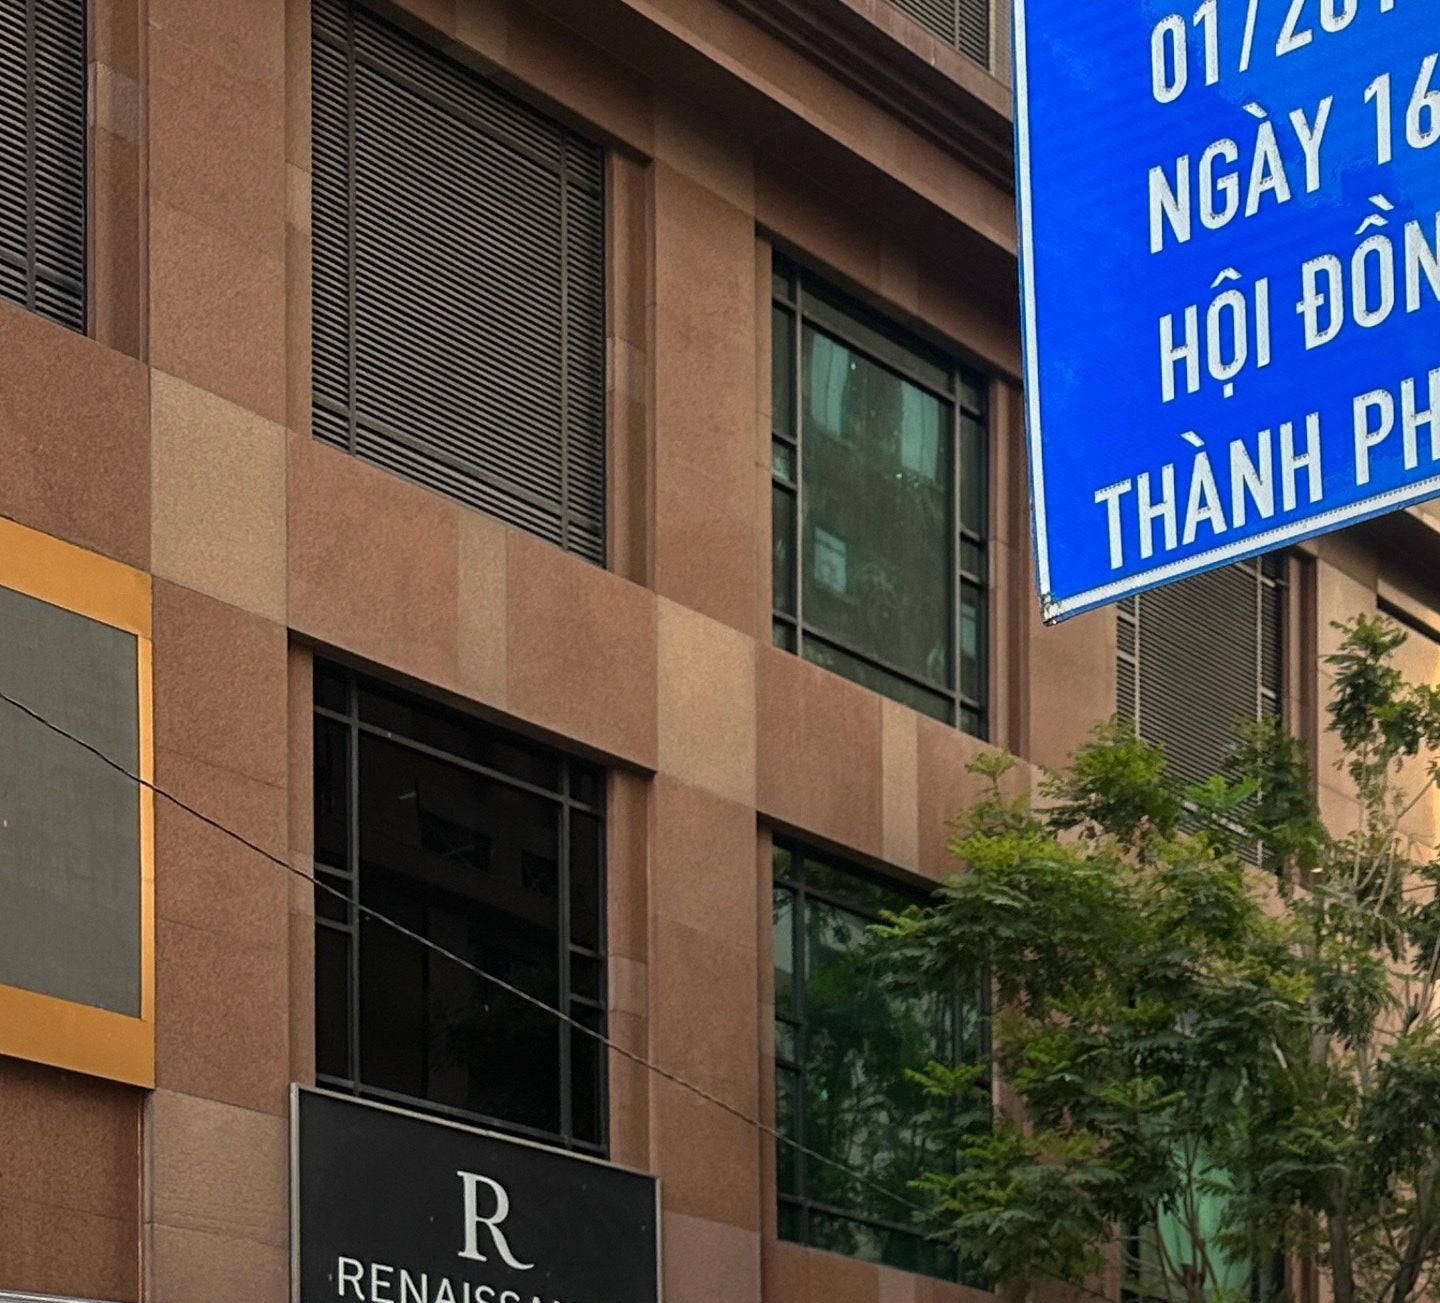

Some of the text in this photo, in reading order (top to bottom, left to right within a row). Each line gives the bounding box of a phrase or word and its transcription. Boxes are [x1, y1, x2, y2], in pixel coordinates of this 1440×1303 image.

[1152, 0, 1394, 103] 01/2
[1149, 96, 1332, 253] NGÀY
[1160, 267, 1270, 404] HỘI
[1094, 413, 1323, 570] THÀNH
[457, 1171, 535, 1271] R
